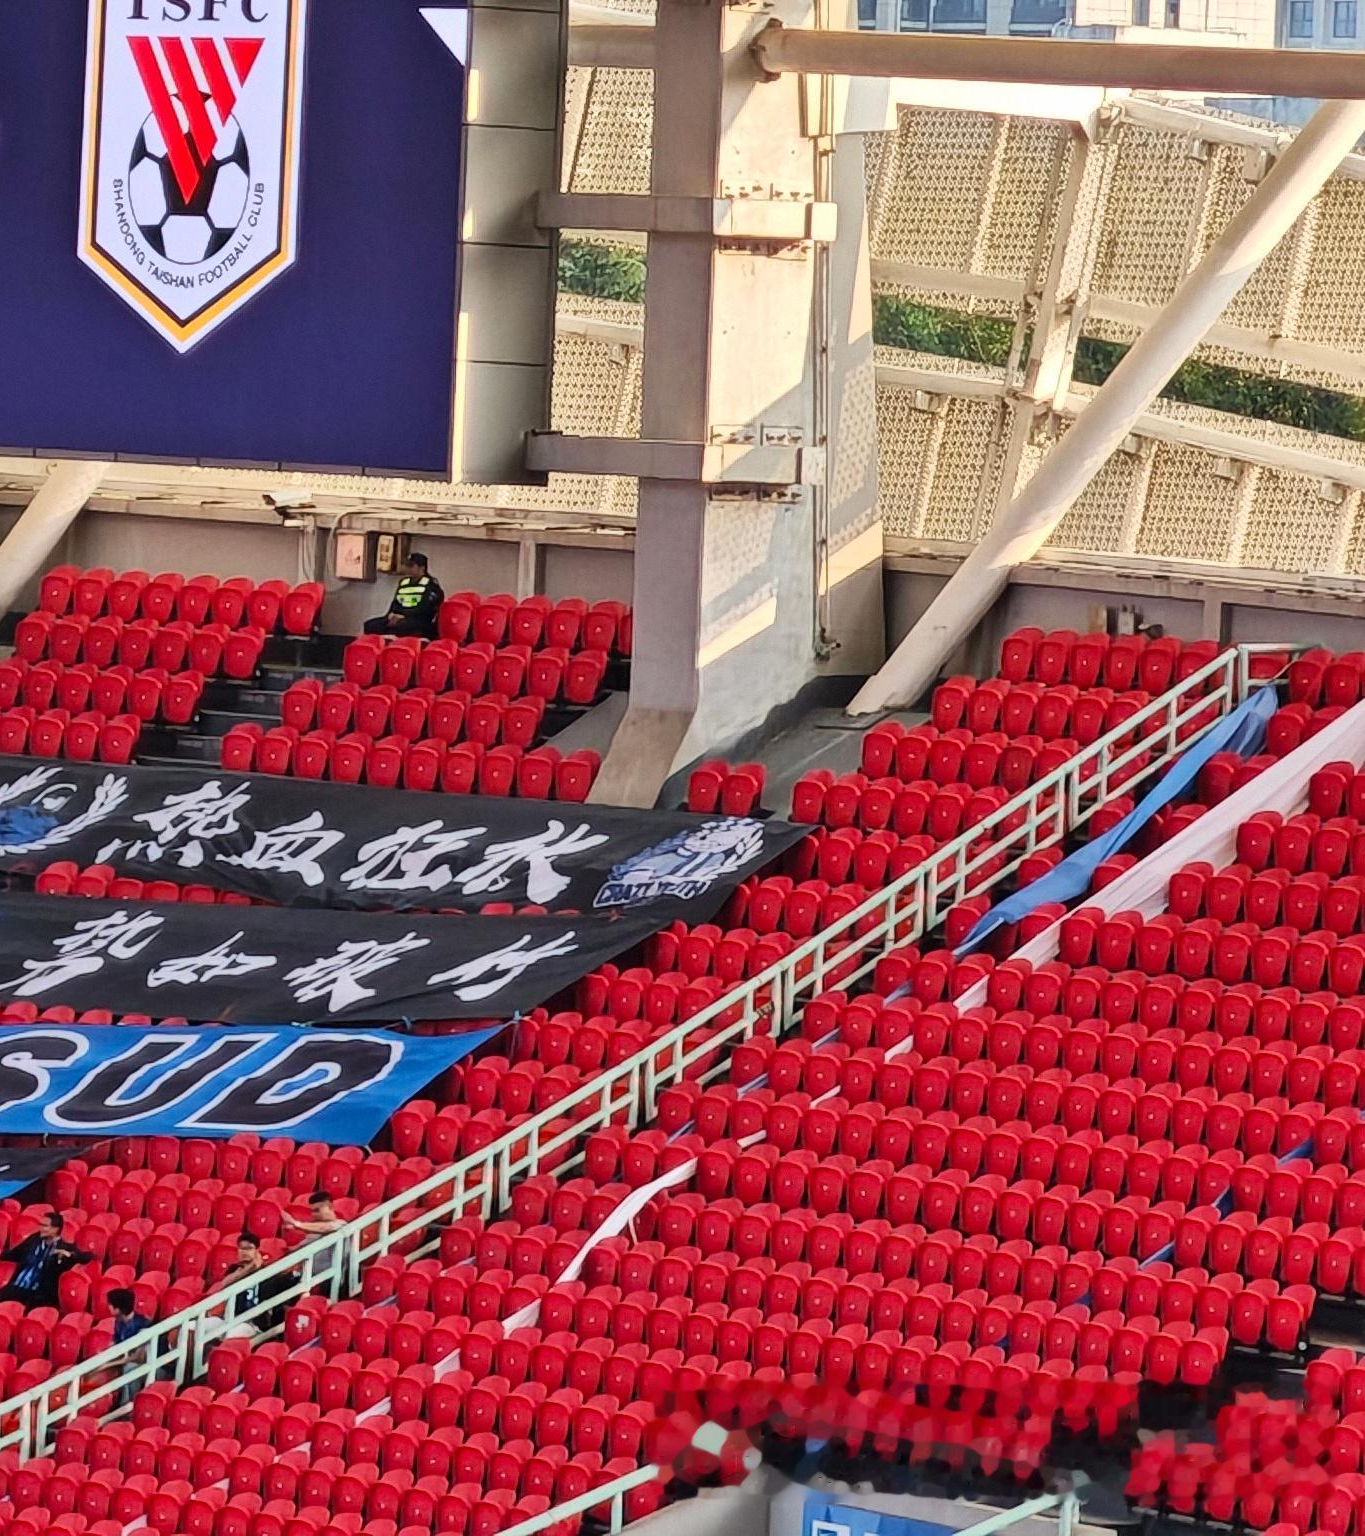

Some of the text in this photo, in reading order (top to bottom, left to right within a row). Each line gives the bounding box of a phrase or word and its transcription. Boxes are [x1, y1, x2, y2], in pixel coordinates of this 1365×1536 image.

[113, 178, 265, 289] SHANDONG TAISHAN FOOTBALL CLUB
